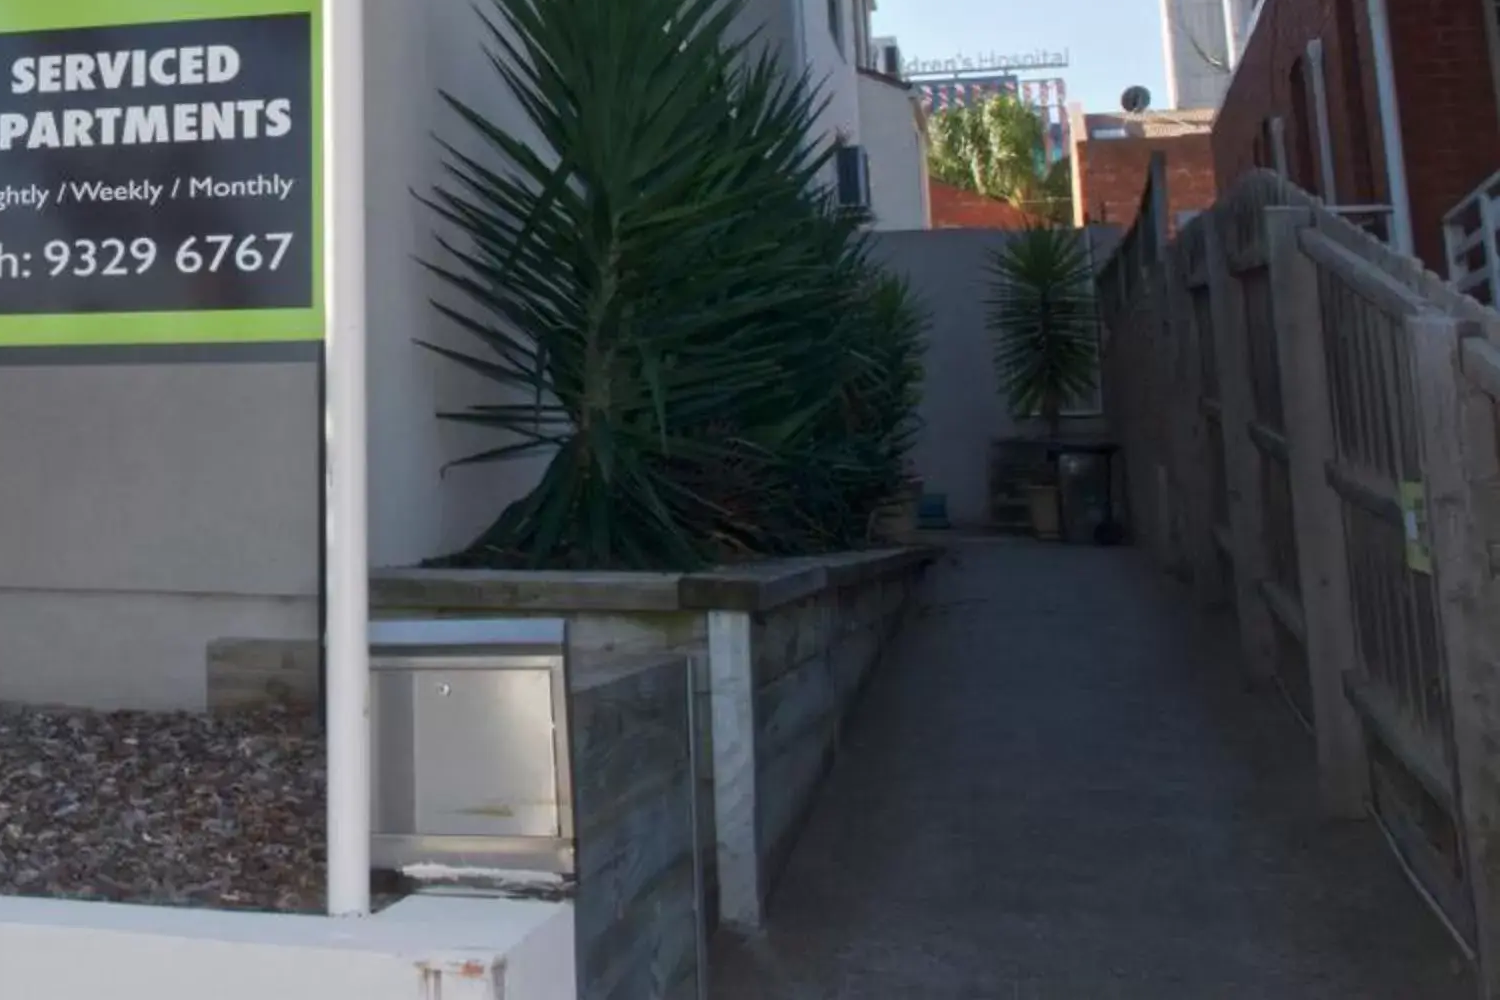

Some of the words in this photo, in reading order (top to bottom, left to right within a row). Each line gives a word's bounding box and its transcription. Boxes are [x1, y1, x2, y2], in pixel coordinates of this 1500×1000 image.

[11, 45, 241, 94] SERVICED
[902, 52, 973, 72] dren's
[978, 46, 1069, 70] Hospital
[189, 173, 294, 200] Monthly
[43, 236, 158, 277] 9329
[174, 231, 294, 273] 6767
